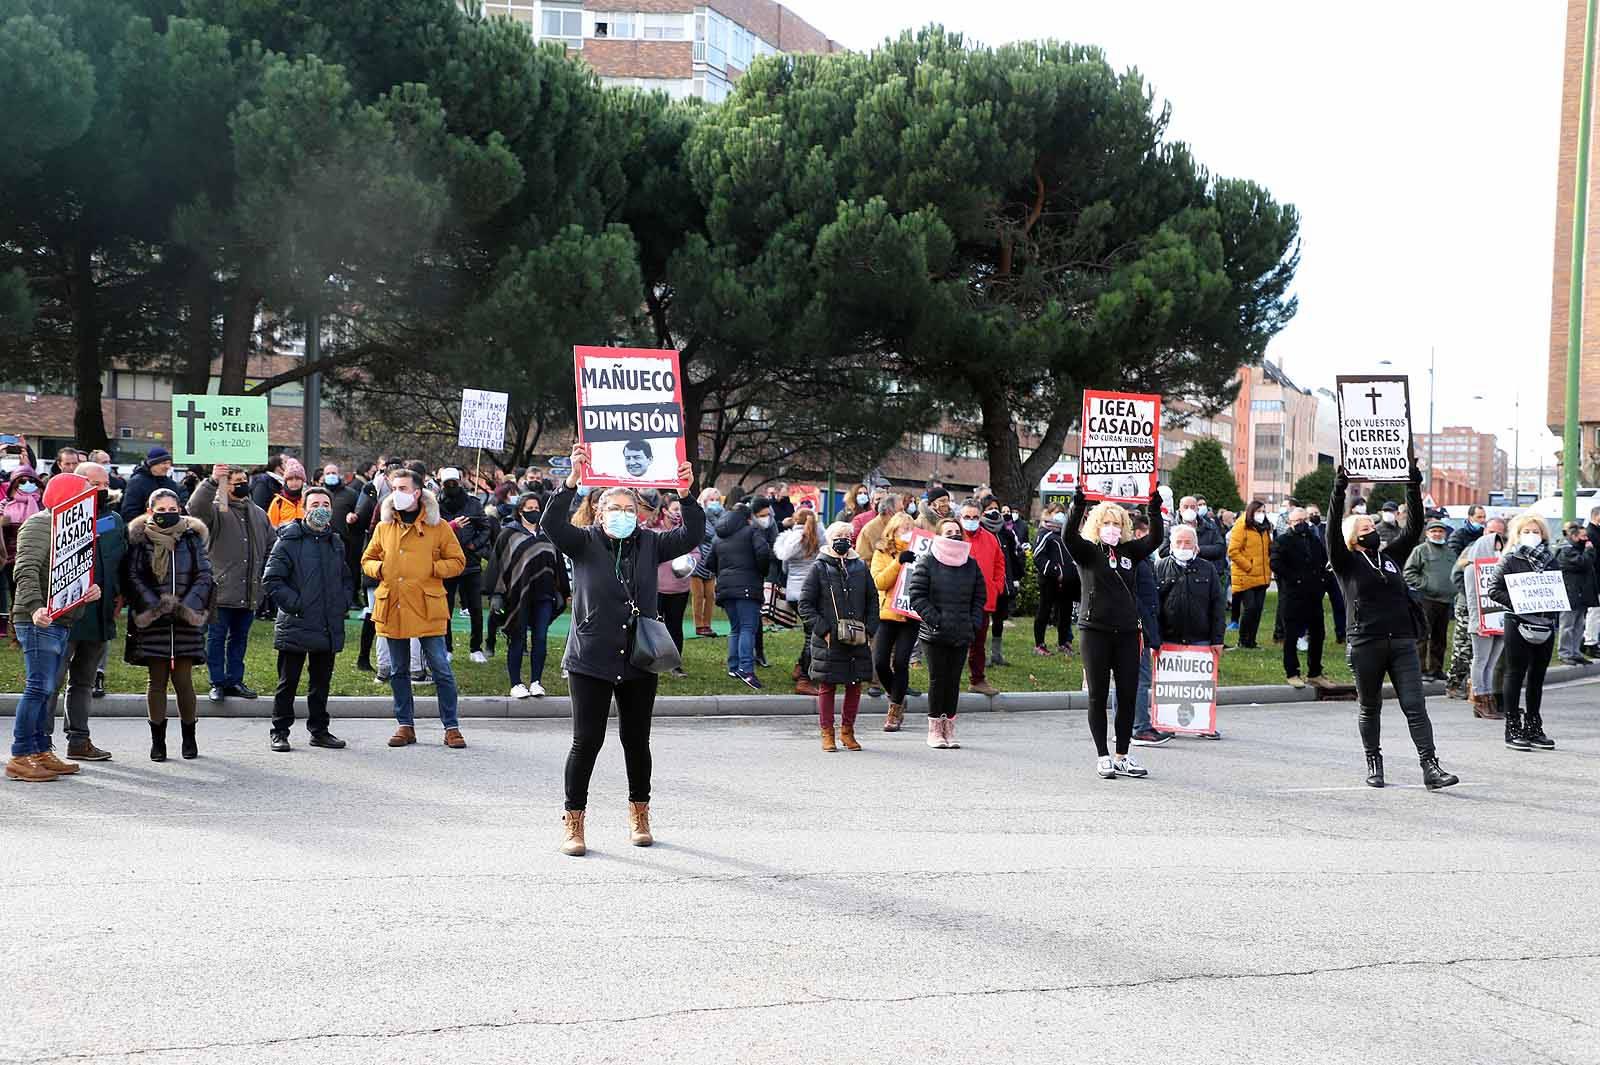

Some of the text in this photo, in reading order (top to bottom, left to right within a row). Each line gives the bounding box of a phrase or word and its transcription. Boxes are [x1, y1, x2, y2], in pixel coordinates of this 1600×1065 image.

[581, 364, 676, 392] MAÑUECO
[480, 392, 491, 401] NO
[464, 399, 506, 412] PERMITAMOS
[1099, 400, 1136, 417] IGEA
[463, 409, 500, 421] QUE LOS
[584, 409, 679, 433] DIMISIÓN
[1088, 417, 1153, 437] CASADO
[1345, 419, 1406, 427] CON VUESTROS
[496, 431, 503, 440] LA
[1101, 434, 1122, 442] CURAN
[1124, 436, 1152, 445] HERIDAS
[1349, 429, 1405, 445] CIERRES,
[1083, 447, 1127, 461] MATAN
[1139, 452, 1153, 460] LOS
[1352, 446, 1401, 455] NOS ESTAIS
[1083, 461, 1154, 473] HOSTELEROS
[1347, 457, 1407, 470] MATANDO
[61, 503, 84, 529] IGEA
[55, 516, 94, 551] CASADO
[62, 544, 76, 556] CURAN
[76, 534, 93, 549] HERIDAS
[52, 553, 78, 581] MATAN
[84, 547, 93, 560] LOS
[52, 558, 93, 596] HOSTELEROS
[1508, 578, 1520, 588] LA
[1517, 600, 1543, 612] SALVA
[1543, 599, 1565, 611] VIDAS
[1156, 655, 1214, 673] MAÑUECO
[1155, 684, 1212, 700] DIMISIÓN
